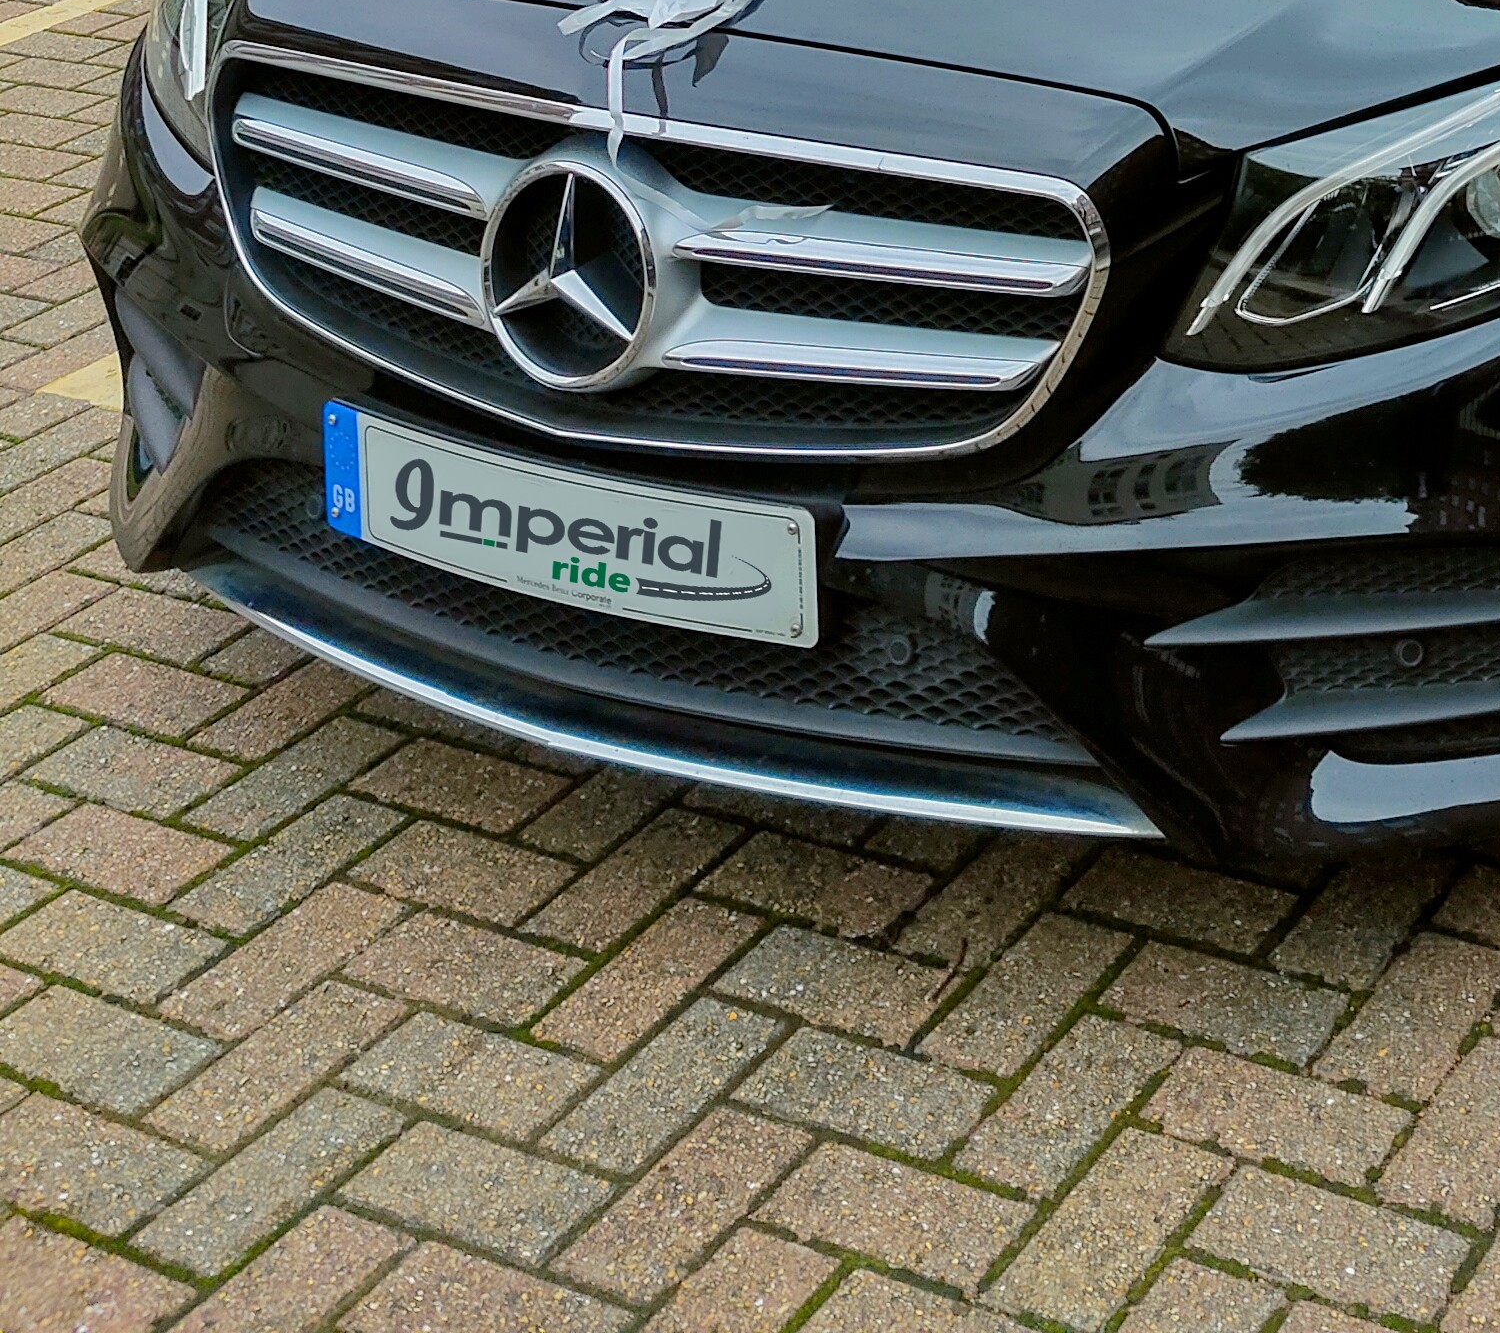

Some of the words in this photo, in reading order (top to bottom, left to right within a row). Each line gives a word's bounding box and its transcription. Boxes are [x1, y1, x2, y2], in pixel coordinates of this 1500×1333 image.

[333, 484, 356, 513] GB
[552, 556, 631, 593] ride
[516, 575, 550, 591] Mercedes
[571, 589, 612, 605] Corporate
